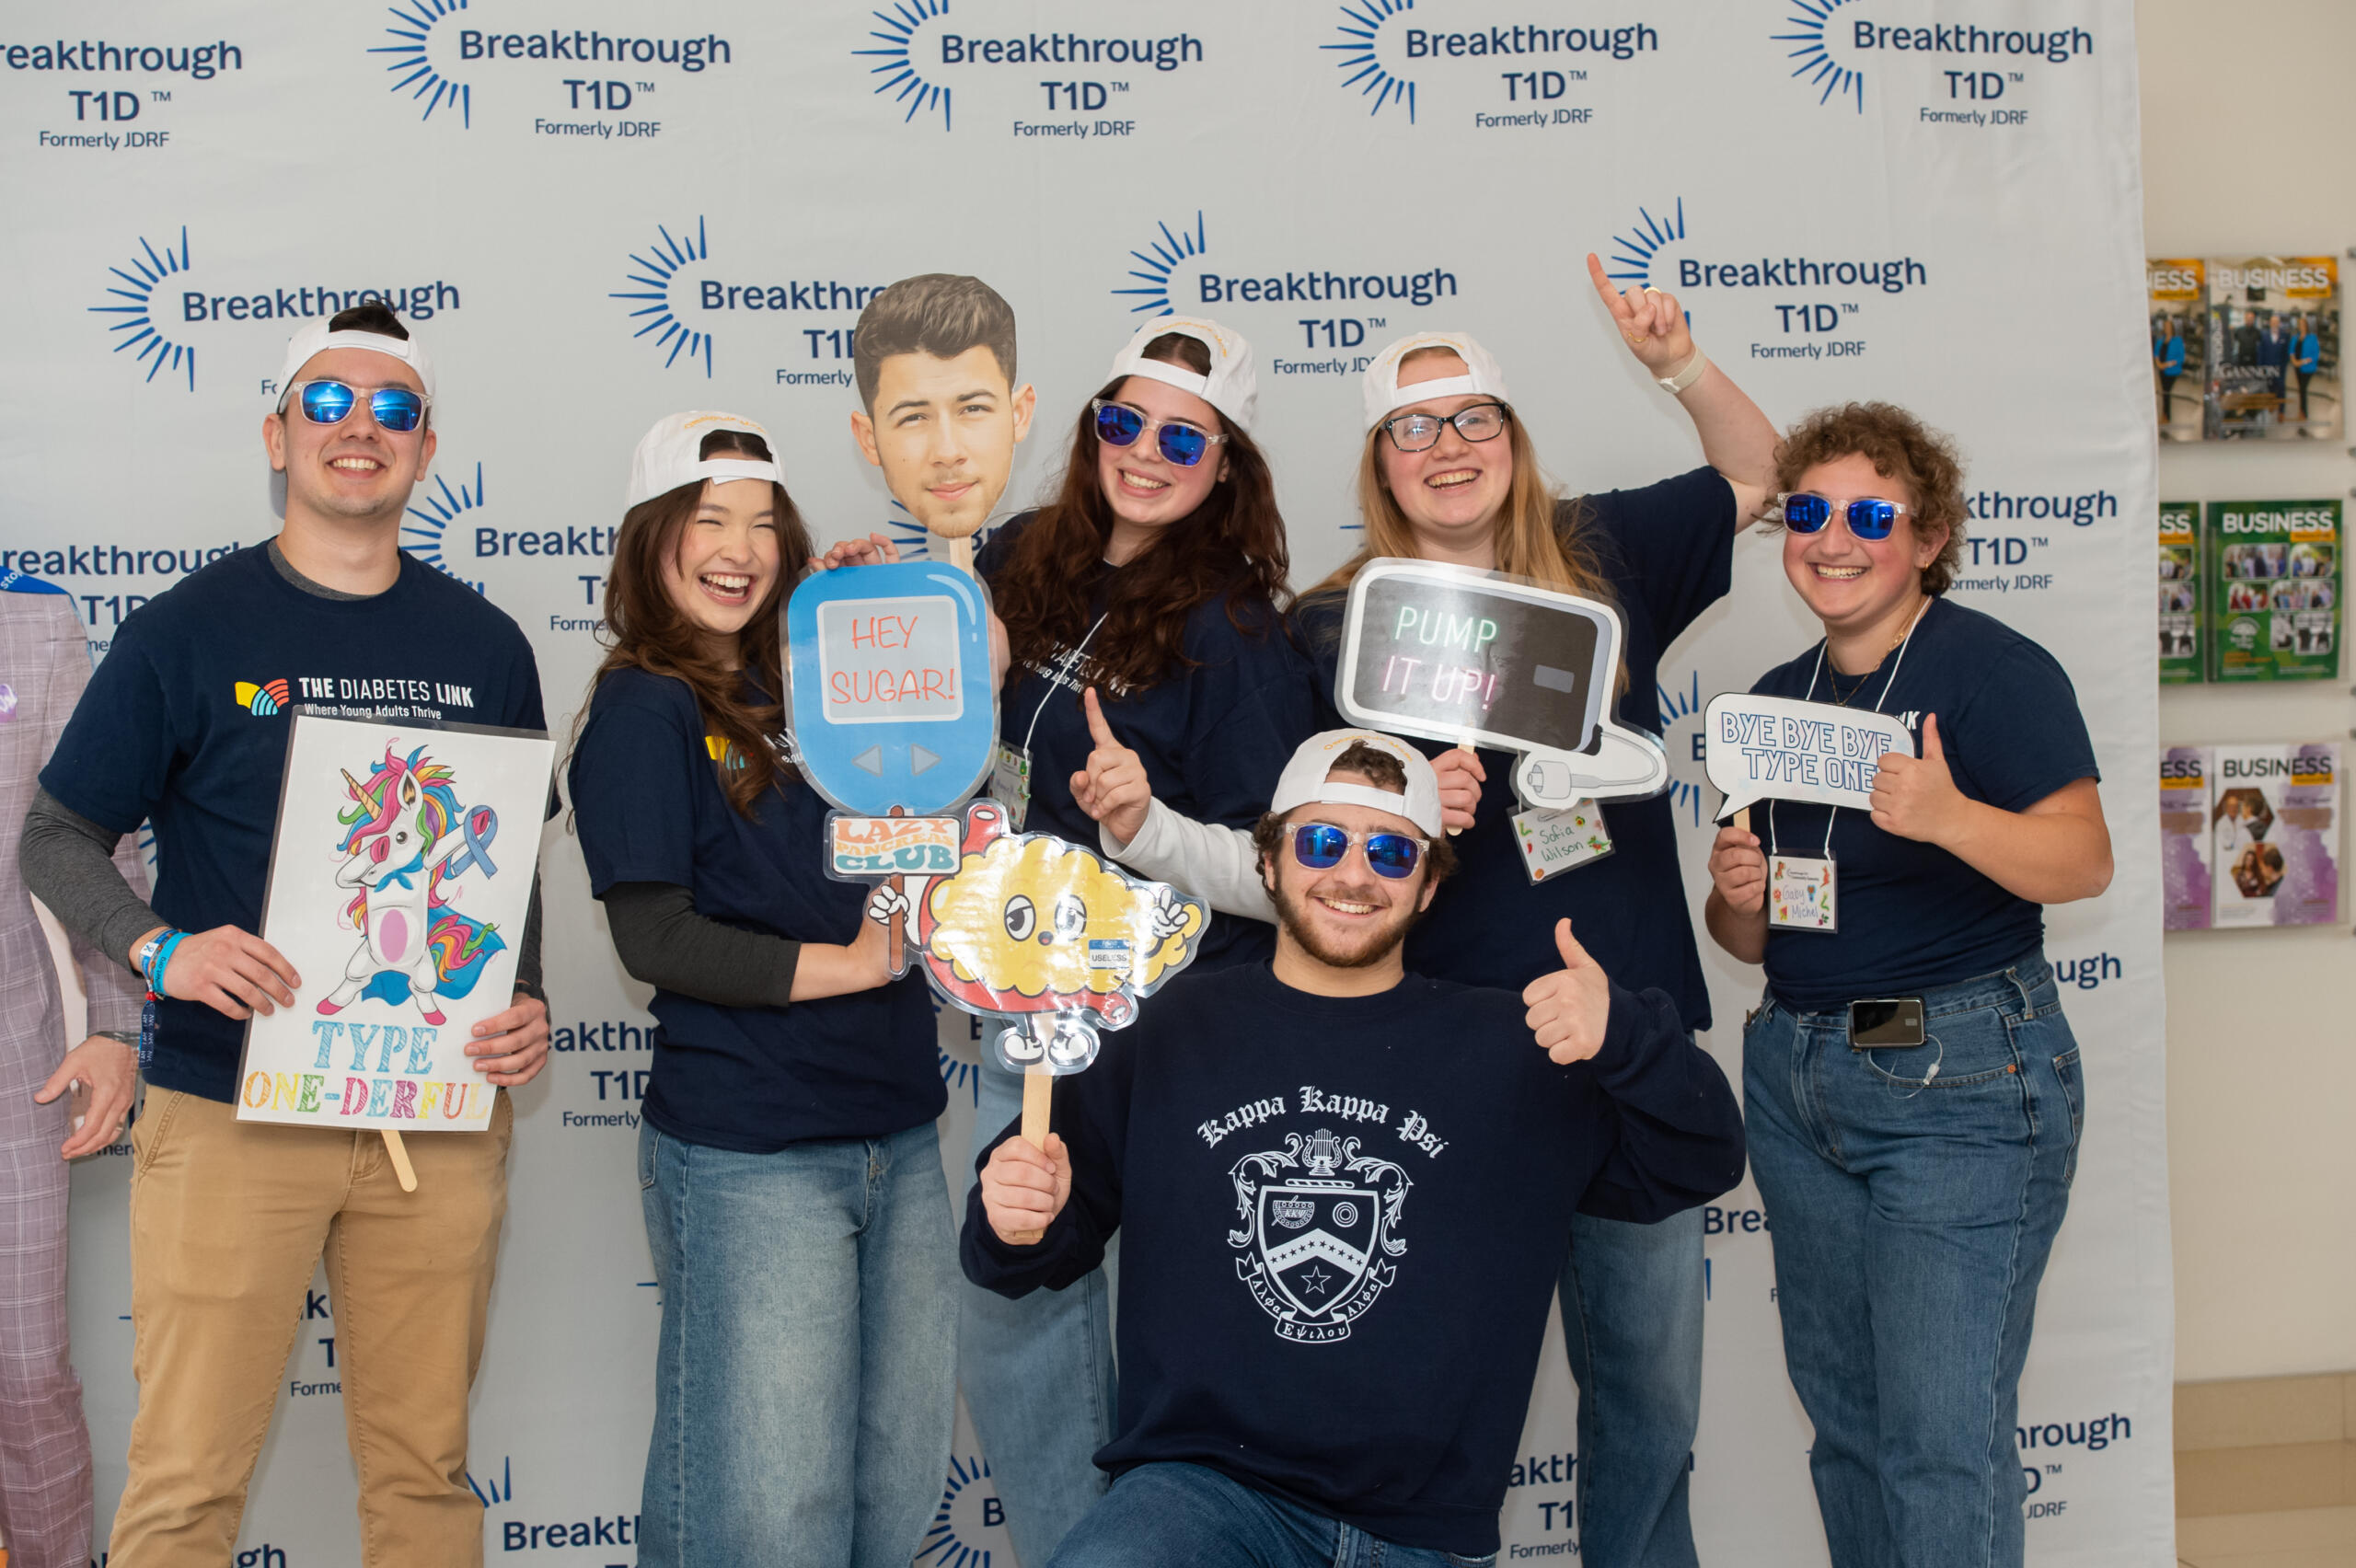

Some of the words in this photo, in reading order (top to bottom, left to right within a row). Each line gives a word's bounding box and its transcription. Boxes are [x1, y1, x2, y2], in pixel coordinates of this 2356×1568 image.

[461, 30, 730, 72] Breakthrough
[942, 33, 1202, 71] Breakthrough
[1407, 23, 1657, 60] Breakthrough
[1854, 21, 2092, 63] Breakthrough
[0, 40, 242, 79] eakthrough
[563, 80, 631, 110] T1D
[1041, 82, 1106, 110] T1D
[1502, 72, 1565, 100] T1D
[1944, 71, 2004, 99] T1D
[69, 91, 139, 121] T1D
[1476, 110, 1548, 127] Formerly
[1553, 109, 1592, 123] JDRF
[1921, 108, 1986, 127] Formerly
[1991, 110, 2027, 124] JDRF
[40, 131, 120, 151] Formerly
[124, 132, 169, 147] JDRF
[536, 119, 612, 139] Formerly
[618, 121, 661, 137] JDRF
[1014, 121, 1088, 139] Formerly
[1093, 121, 1135, 135] JDRF
[1200, 269, 1457, 306] Breakthrough
[1680, 258, 1926, 293] Breakthrough
[2218, 269, 2329, 289] BUSINESS
[700, 281, 885, 310] Breakthr
[1775, 305, 1838, 332] T1D
[1299, 319, 1364, 348] T1D
[1751, 343, 1821, 360] Formerly
[1826, 341, 1865, 356] JDRF
[776, 369, 853, 387] Formerly
[1274, 358, 1346, 375] Formerly
[1351, 356, 1377, 373] JD
[2223, 511, 2334, 533] BUSINESS
[1967, 538, 2027, 565] T1D
[1949, 575, 2010, 593] ormerly
[2014, 574, 2053, 590] JDRF
[851, 615, 918, 650] HEY
[1394, 605, 1497, 653] PUMP
[299, 677, 335, 698] THE
[340, 678, 431, 701] DIABETES
[435, 683, 474, 708] LINK
[830, 667, 957, 705] SUGAR!
[1382, 655, 1422, 695] IT
[1431, 663, 1496, 710] UP!
[305, 703, 338, 716] Where
[340, 705, 372, 719] Young
[375, 705, 410, 718] Adults
[411, 706, 442, 720] Thrive
[1721, 711, 1776, 747] BYE
[1783, 717, 1836, 755] BYE
[1841, 725, 1892, 760] BYE
[1742, 747, 1819, 786] TYPE
[1825, 757, 1881, 793] ONE
[2223, 756, 2332, 778] BUSINESS
[835, 819, 955, 844] LAZY
[836, 833, 955, 856] PANCREAS
[1540, 824, 1575, 845] Sofia
[836, 845, 955, 870] CLUB
[1542, 841, 1584, 862] Wilson
[312, 1020, 437, 1075] TYPE
[242, 1071, 490, 1120] ONE-DERFUL
[563, 1111, 641, 1129] Formerly
[1197, 1096, 1287, 1149] Kappa
[1299, 1085, 1390, 1124] Kappa
[1396, 1110, 1449, 1159] Psi
[1538, 1500, 1573, 1531] T1
[2026, 1501, 2068, 1519] JDRF
[1509, 1539, 1581, 1560] Formerly
